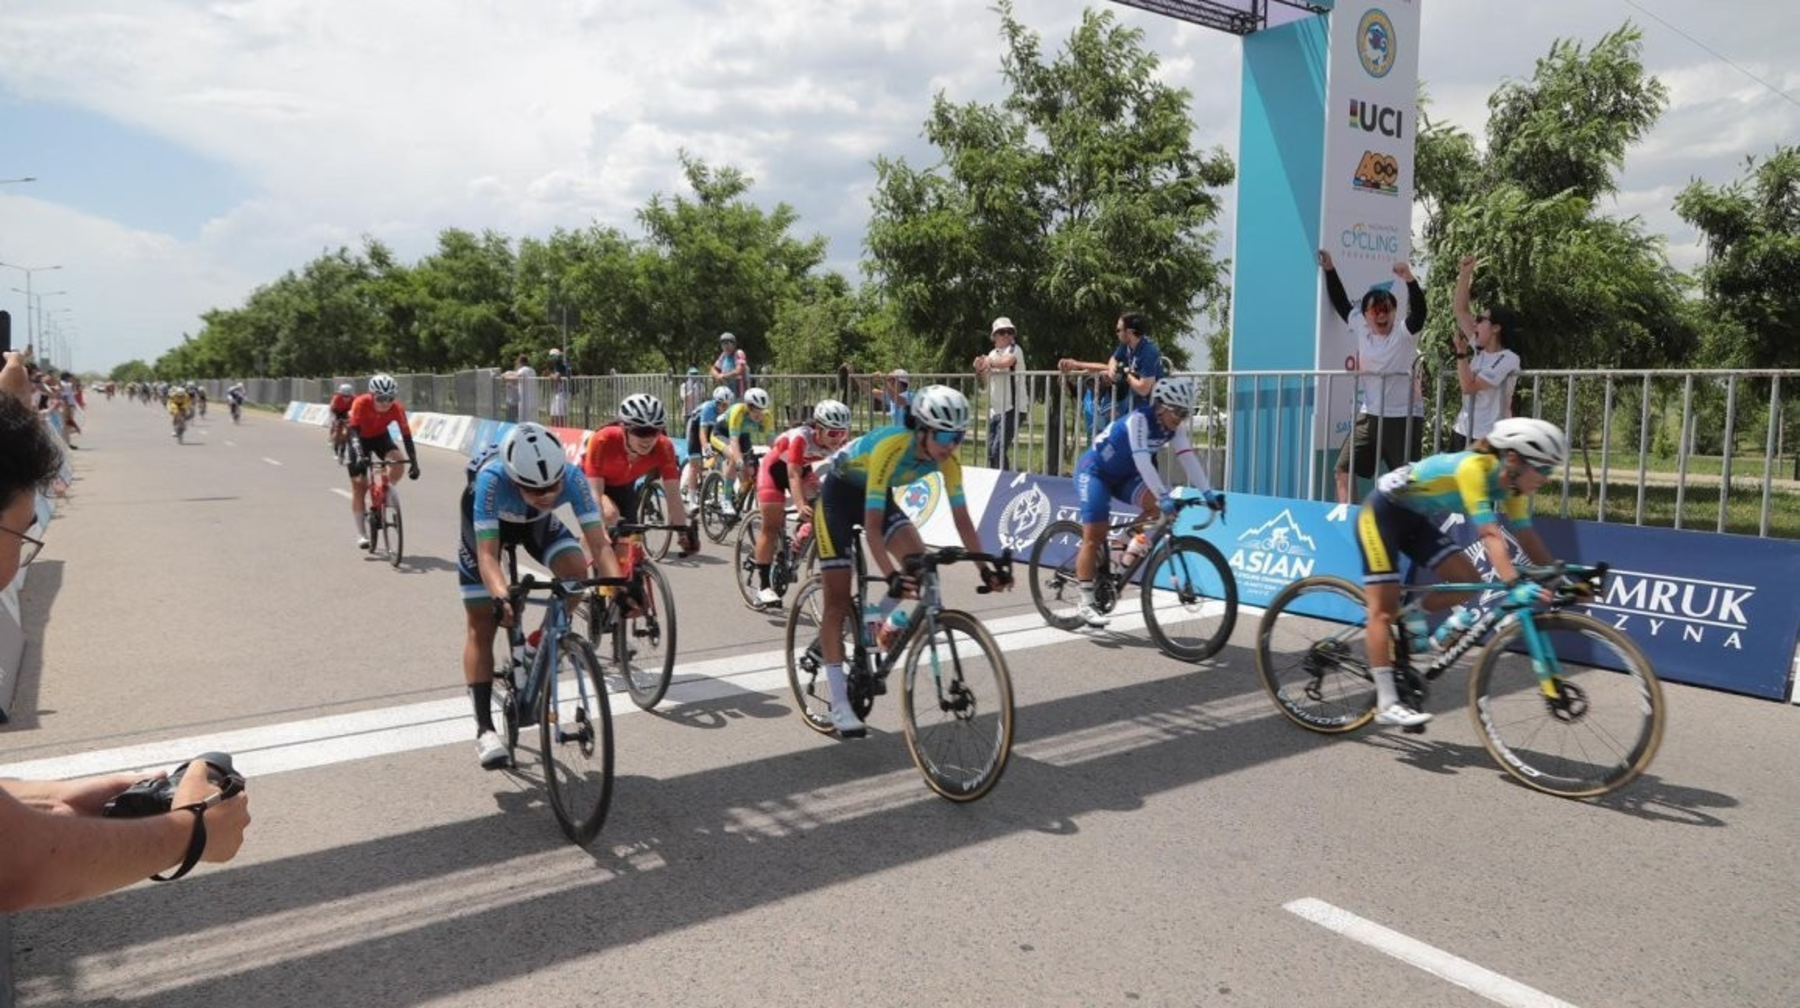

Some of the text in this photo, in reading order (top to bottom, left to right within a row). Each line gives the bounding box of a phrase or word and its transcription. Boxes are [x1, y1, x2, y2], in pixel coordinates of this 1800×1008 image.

[1360, 101, 1402, 138] UCI
[1228, 548, 1315, 579] ASIAN
[1594, 575, 1755, 624] MRUK
